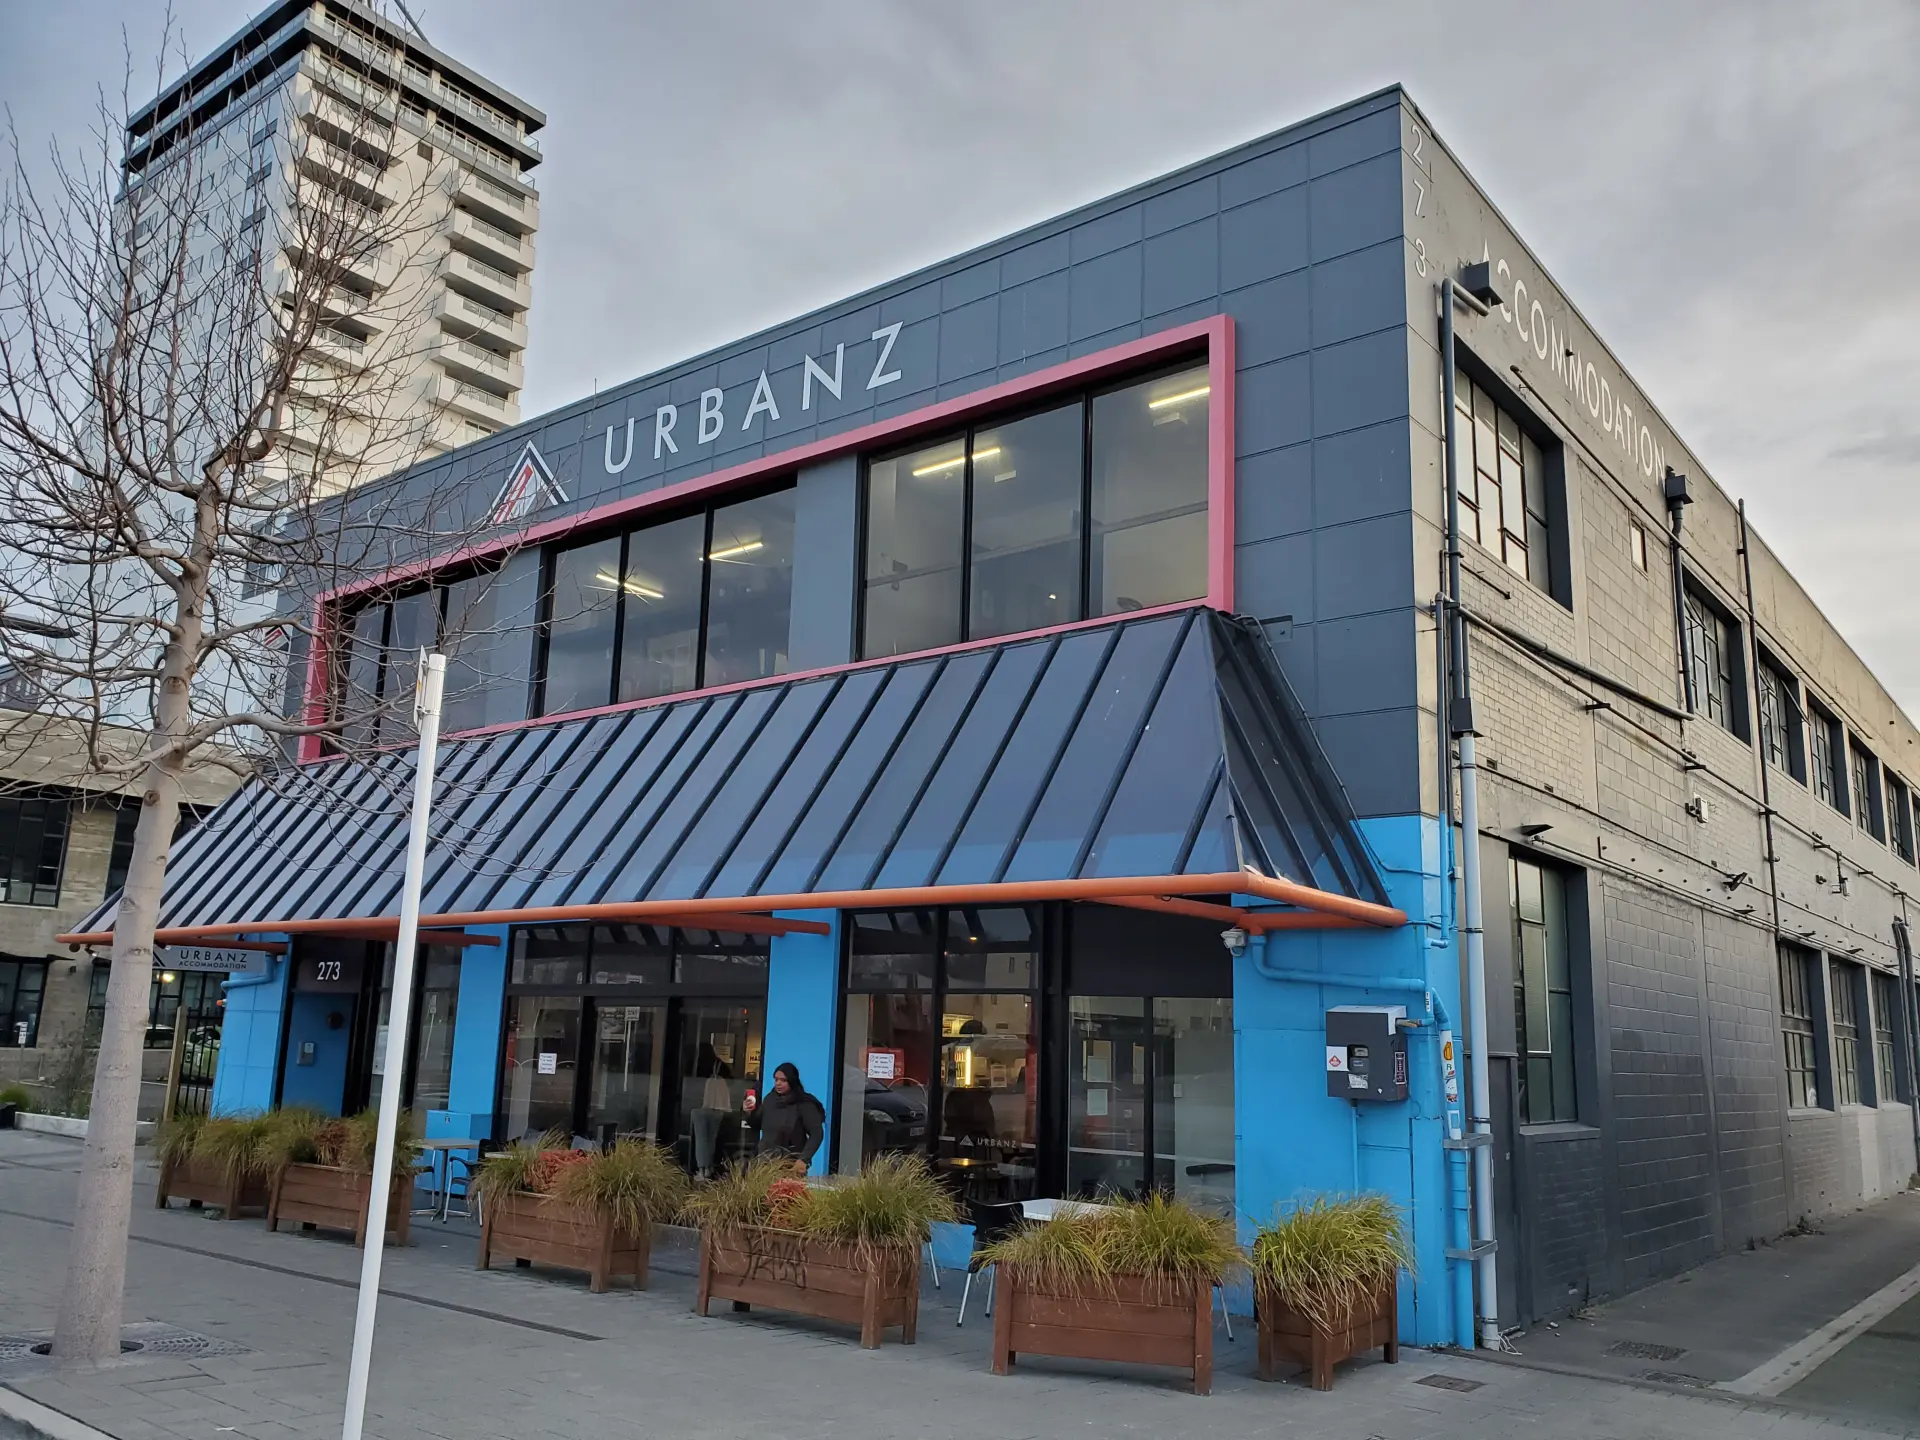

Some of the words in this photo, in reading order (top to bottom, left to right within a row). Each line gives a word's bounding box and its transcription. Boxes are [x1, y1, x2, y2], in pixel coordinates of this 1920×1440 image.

[604, 321, 904, 473] URBANZ
[180, 949, 248, 963] URBANZ
[178, 960, 247, 970] ACCOMMODATION
[316, 961, 341, 981] 273
[977, 1137, 1017, 1149] URBANZ
